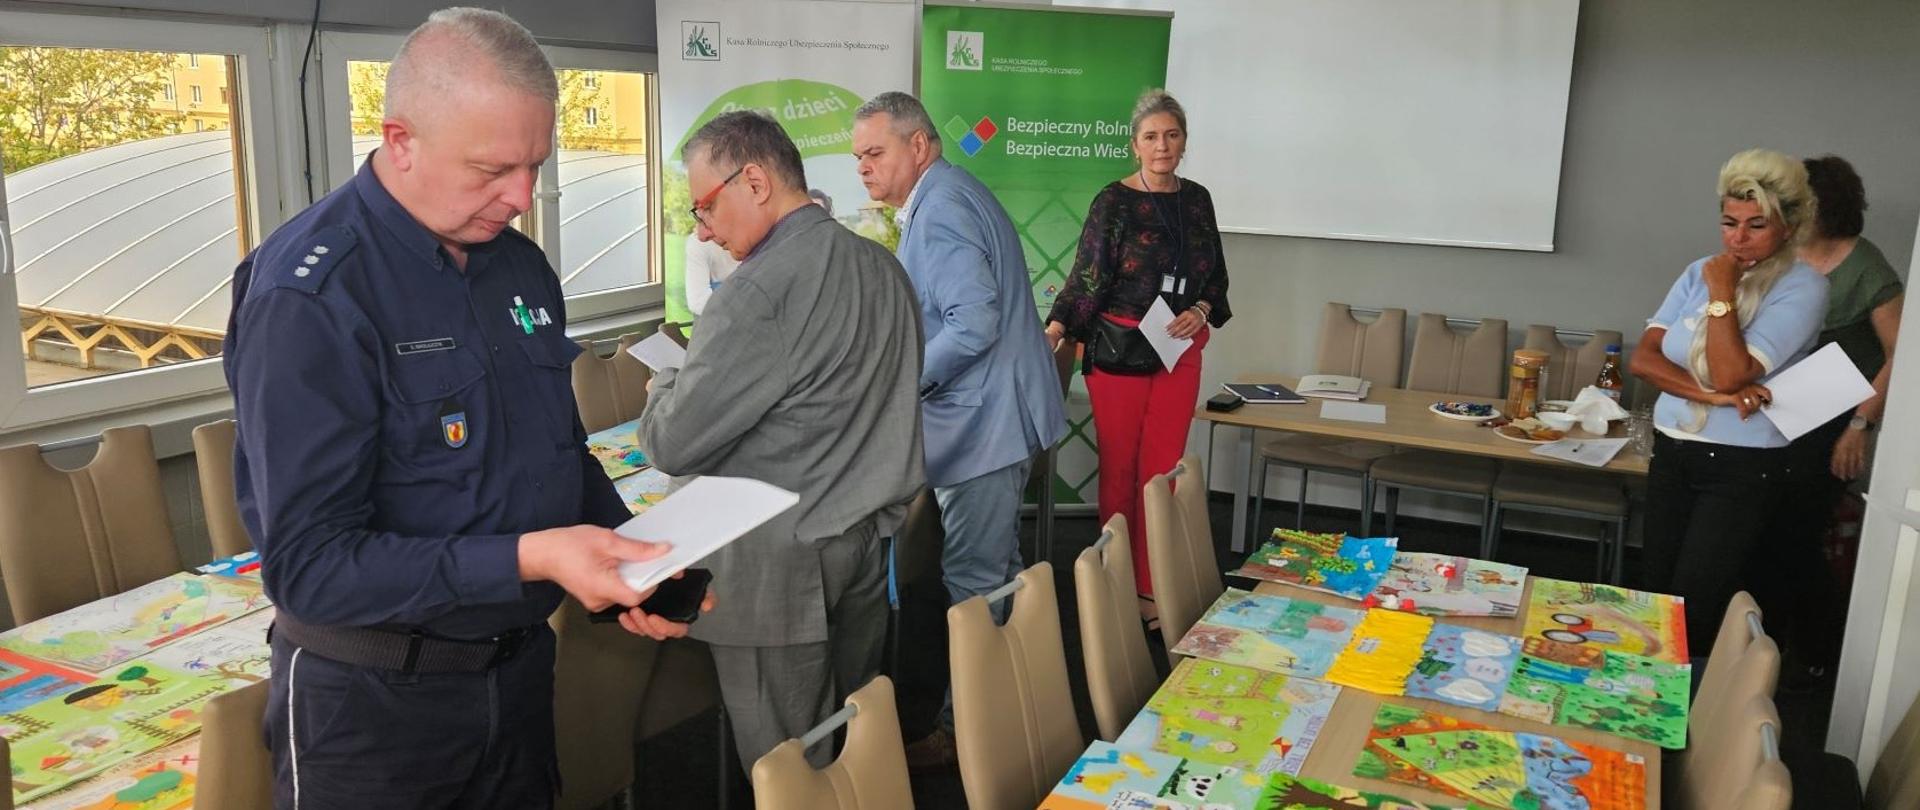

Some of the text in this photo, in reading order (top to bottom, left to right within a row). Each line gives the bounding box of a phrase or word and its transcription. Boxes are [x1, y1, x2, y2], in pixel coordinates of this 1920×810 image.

[726, 36, 890, 51] Kasa Rolniczego Ubezpieczenia Społecznego
[784, 91, 847, 120] dzieci
[1007, 116, 1132, 138] Bezpieczny Rolni
[1006, 140, 1129, 159] Bezpieczna Wieś
